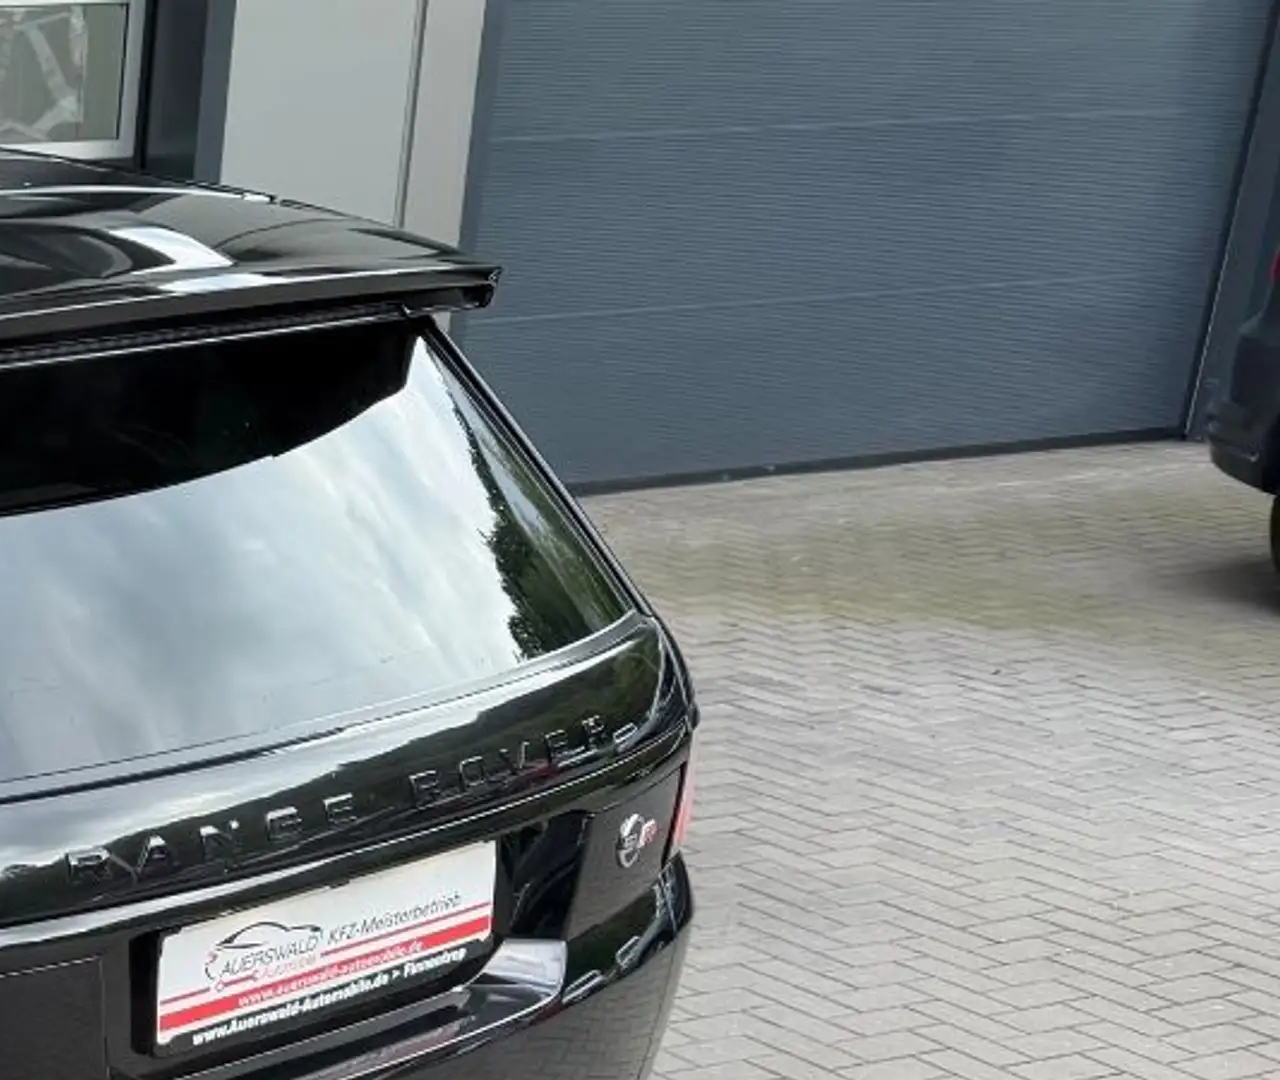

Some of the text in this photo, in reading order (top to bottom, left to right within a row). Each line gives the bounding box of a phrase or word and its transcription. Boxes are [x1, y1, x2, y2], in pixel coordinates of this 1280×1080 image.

[64, 714, 607, 885] RANGE ROVER
[219, 934, 319, 978] AUERSWALD
